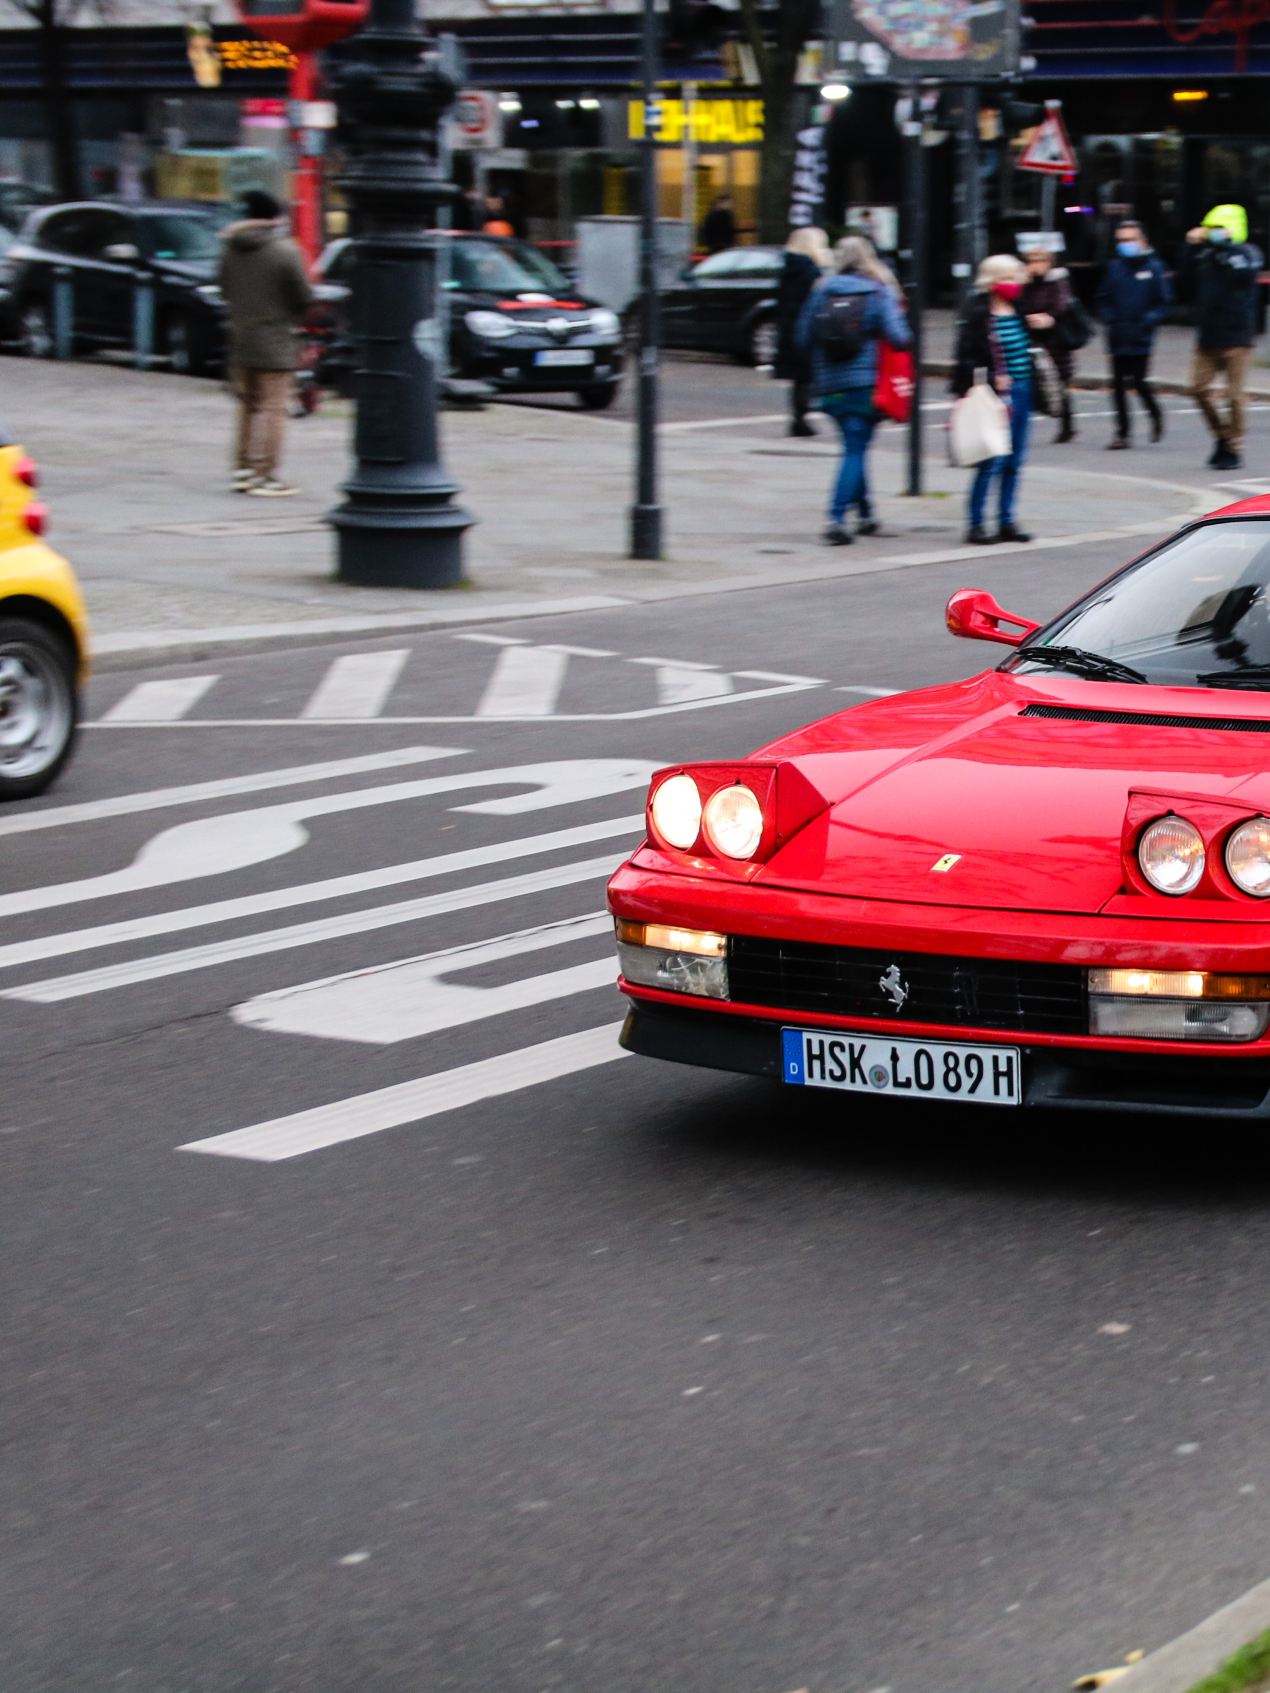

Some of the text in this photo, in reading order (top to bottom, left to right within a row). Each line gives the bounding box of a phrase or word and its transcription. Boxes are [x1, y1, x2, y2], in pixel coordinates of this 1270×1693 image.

[790, 1062, 799, 1075] D
[806, 1038, 868, 1085] HSK
[890, 1046, 935, 1091] LO
